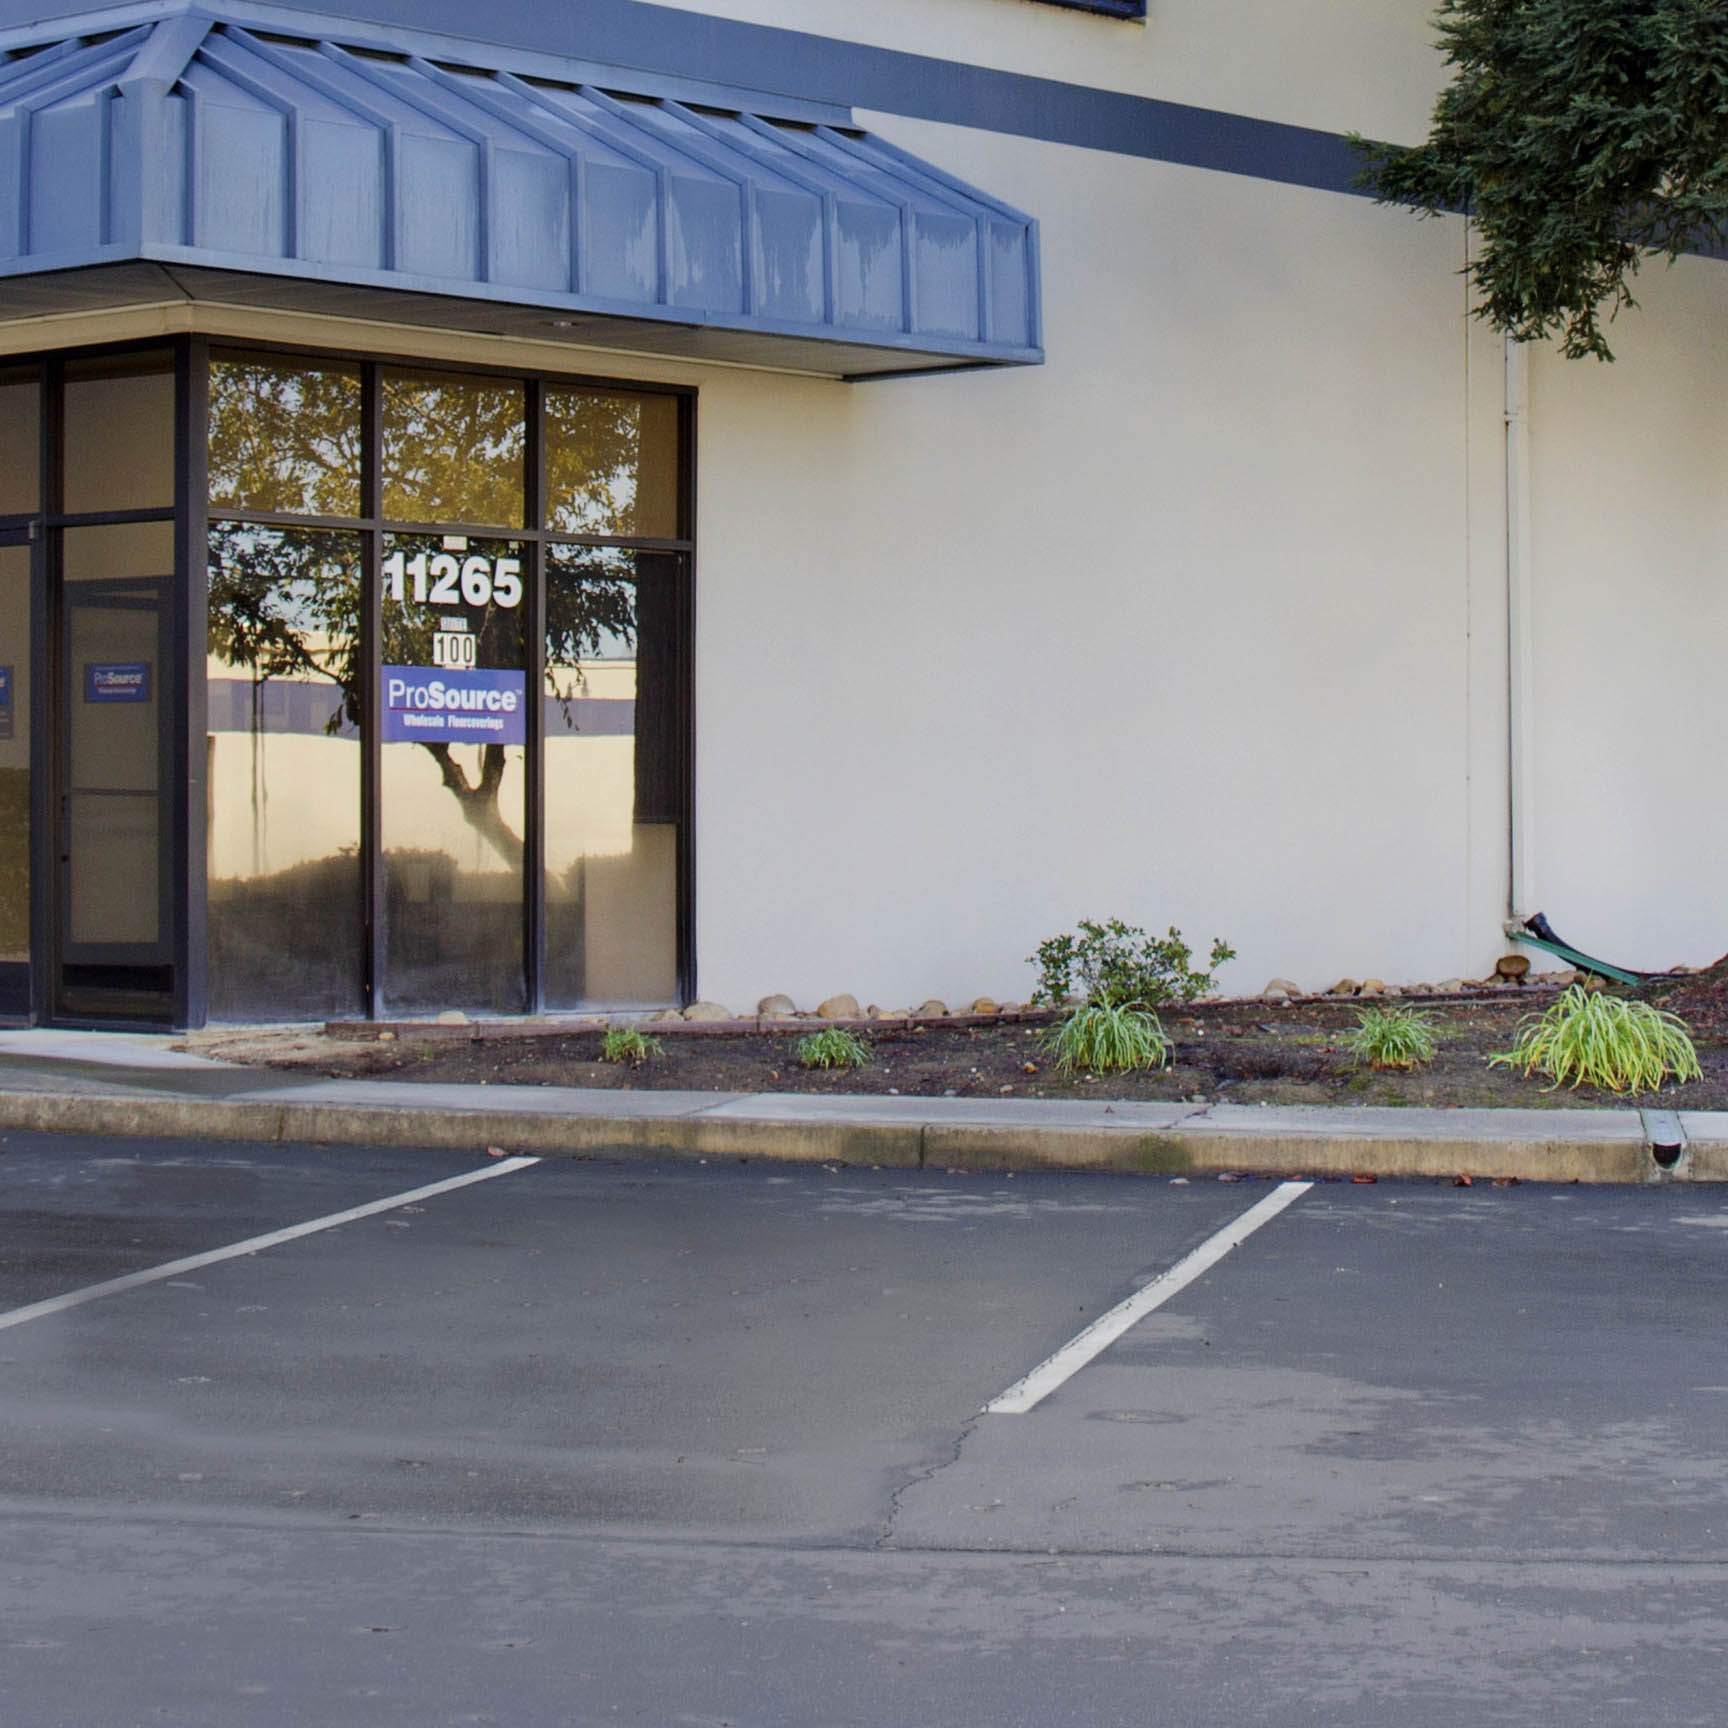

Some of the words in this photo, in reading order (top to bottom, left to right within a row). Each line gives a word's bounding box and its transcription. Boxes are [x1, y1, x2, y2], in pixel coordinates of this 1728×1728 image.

[383, 551, 523, 608] 11265
[437, 636, 472, 663] 100
[94, 672, 142, 685] ProSource
[389, 679, 517, 711] ProSource
[403, 714, 445, 728] Wholesale
[447, 715, 504, 731] Floorcoverings
